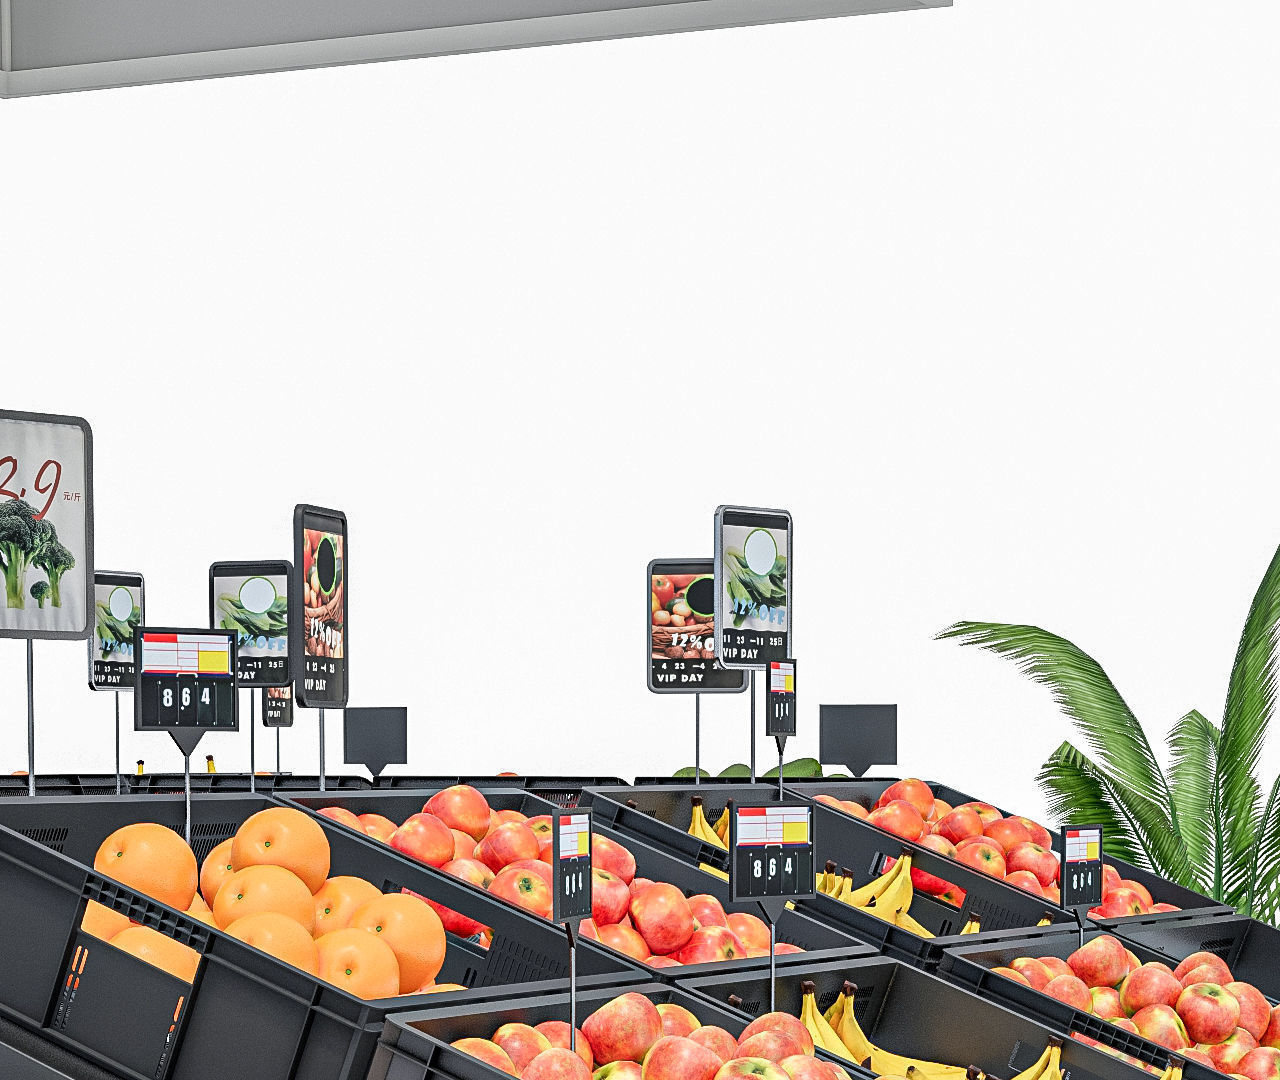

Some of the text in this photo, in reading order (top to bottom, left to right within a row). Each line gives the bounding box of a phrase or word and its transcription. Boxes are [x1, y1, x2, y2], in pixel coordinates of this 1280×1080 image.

[63, 492, 81, 502] 元/斤
[734, 598, 786, 625] 12%OFF
[736, 636, 745, 644] 23
[723, 648, 759, 659] VIP DAY
[94, 675, 121, 683] VIP DAY
[657, 674, 704, 683] VIP DAY
